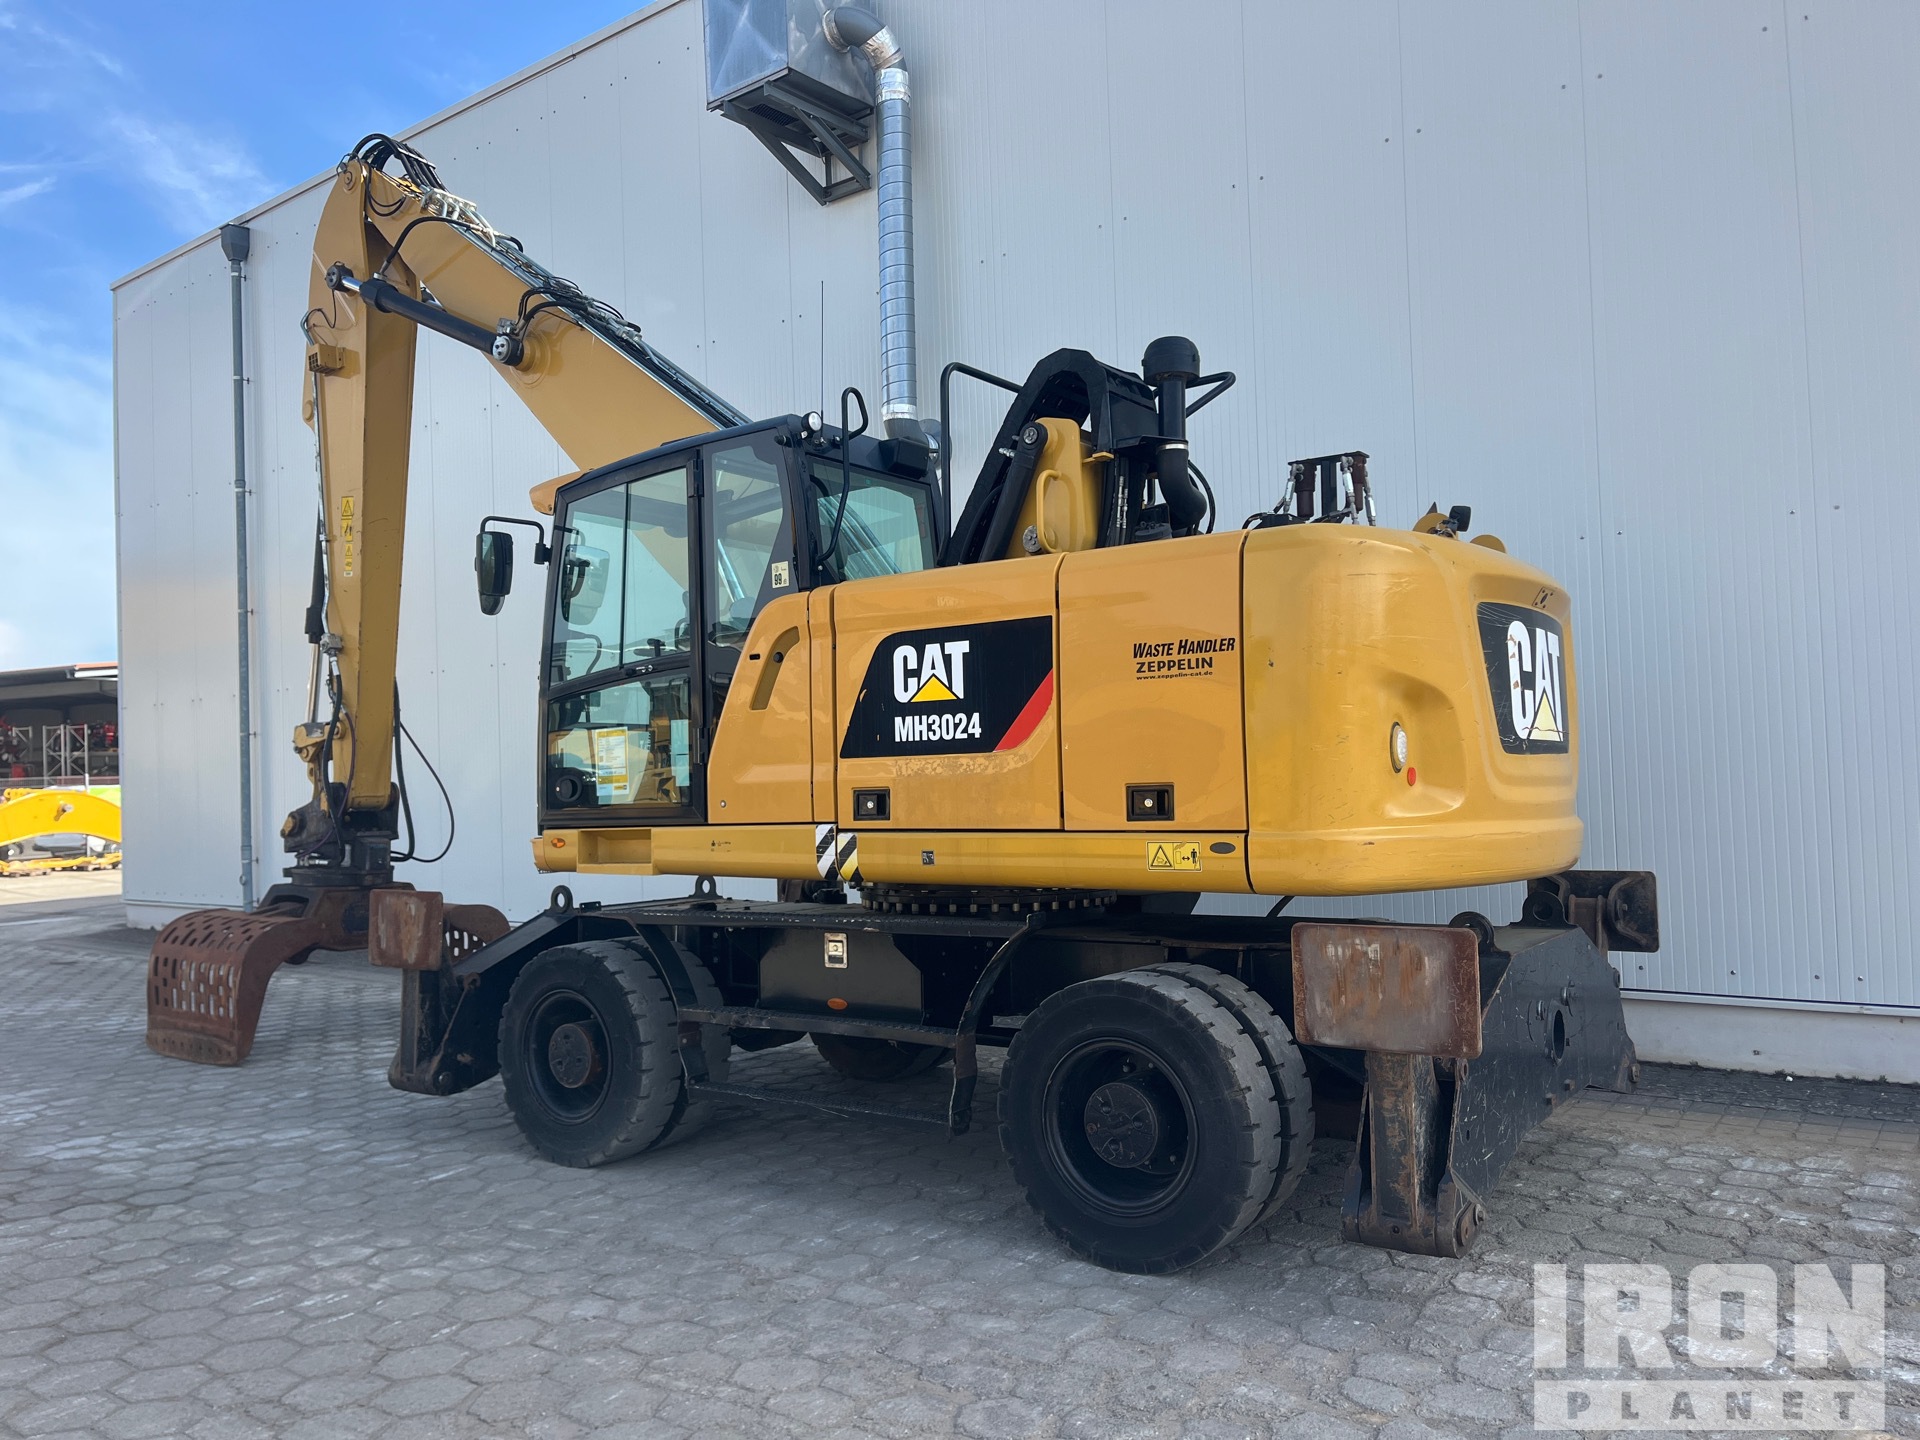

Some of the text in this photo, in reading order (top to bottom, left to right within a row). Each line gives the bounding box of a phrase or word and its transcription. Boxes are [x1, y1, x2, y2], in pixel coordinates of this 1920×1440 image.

[1133, 637, 1236, 659] WASTE HANDLER
[893, 640, 970, 703] CAT
[1136, 656, 1213, 674] ZEPPELIN
[1136, 670, 1213, 680] www.zeppelin-cat.de
[1507, 620, 1564, 742] CAT
[894, 712, 982, 742] MH3024
